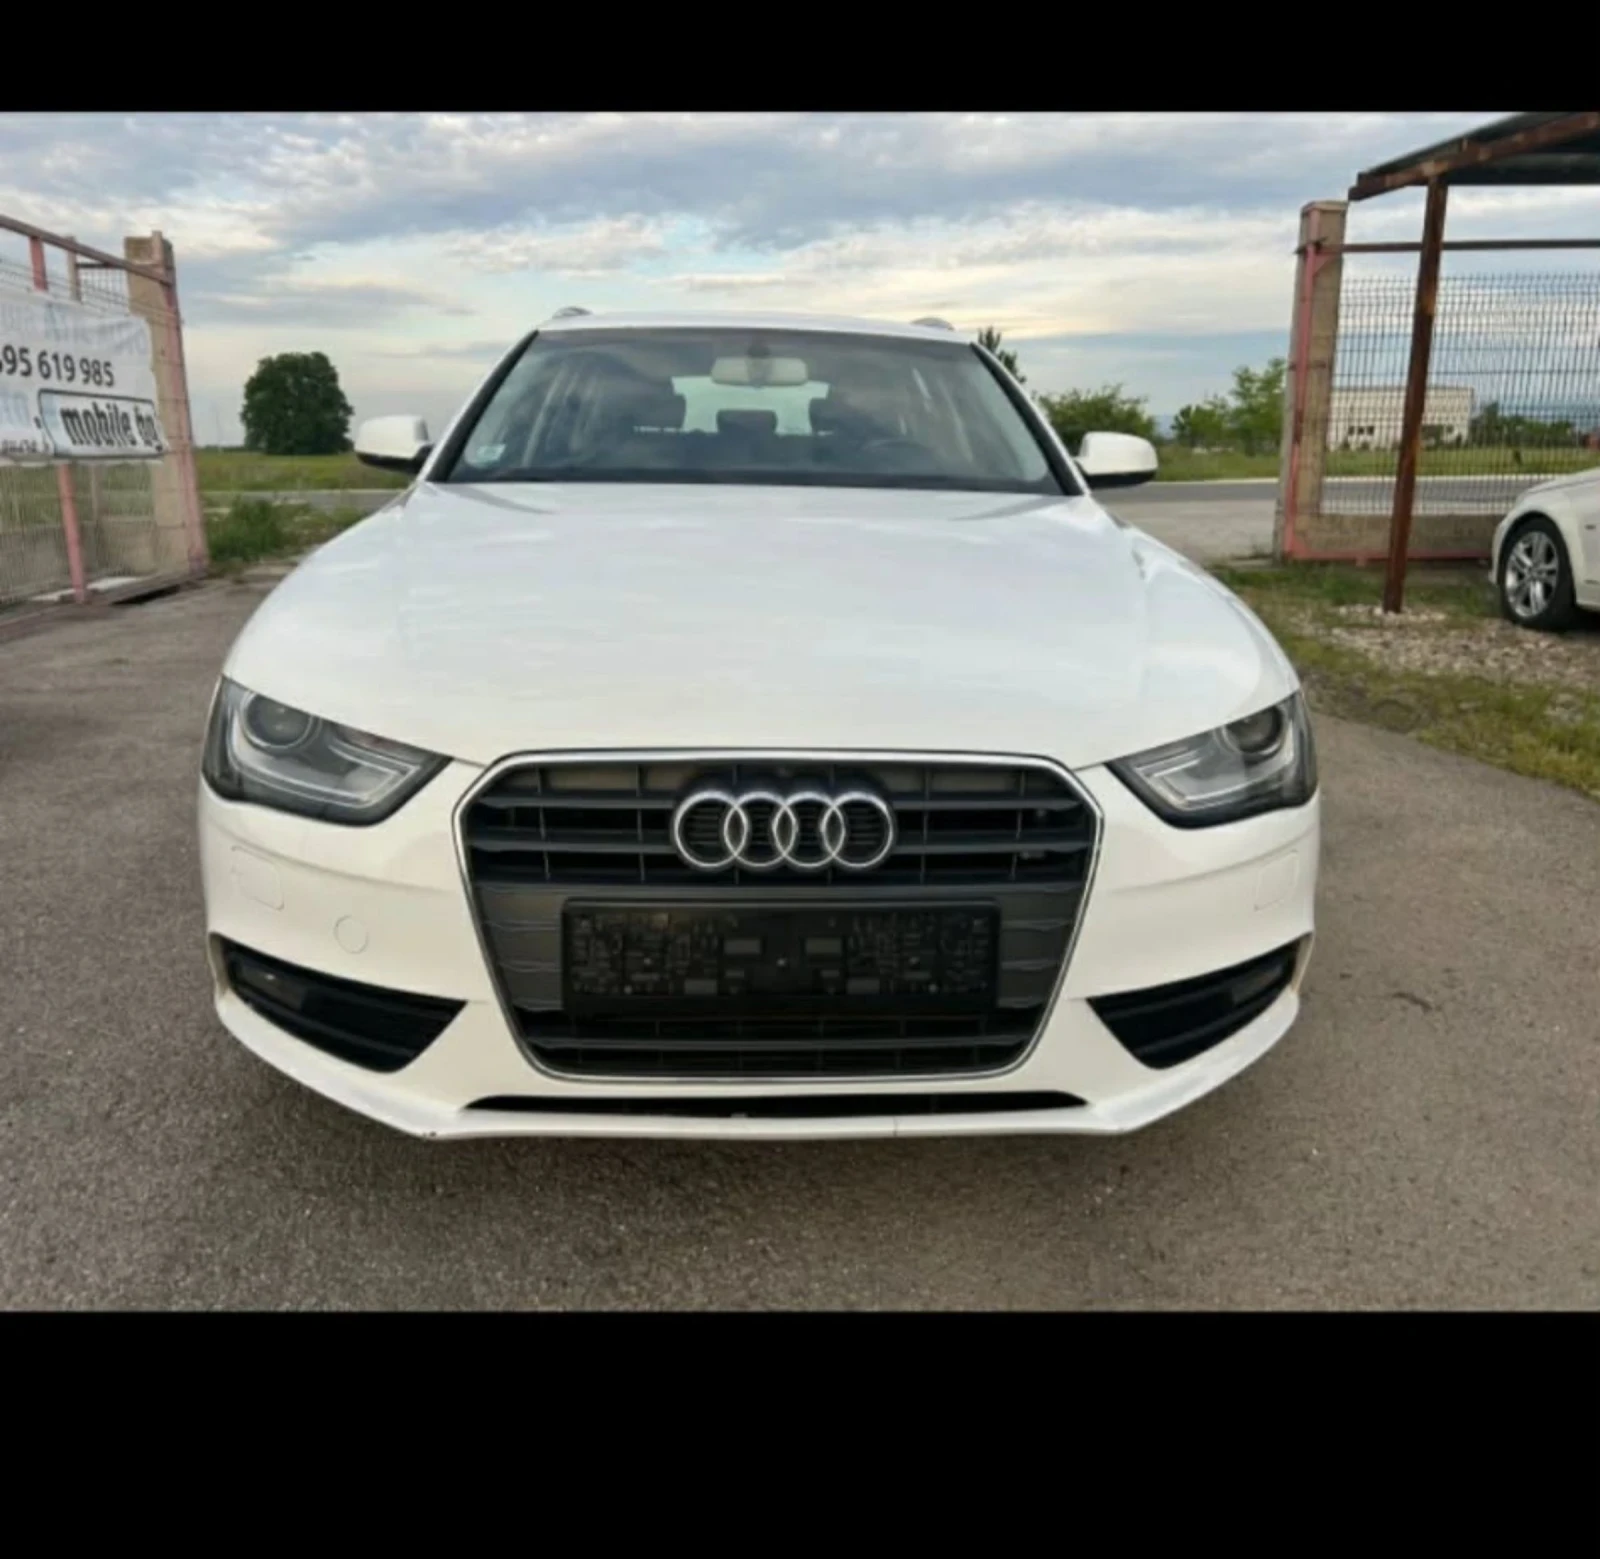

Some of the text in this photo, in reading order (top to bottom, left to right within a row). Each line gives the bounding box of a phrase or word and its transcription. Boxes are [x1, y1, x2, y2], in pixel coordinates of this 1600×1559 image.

[0, 344, 115, 387] 95 619 985
